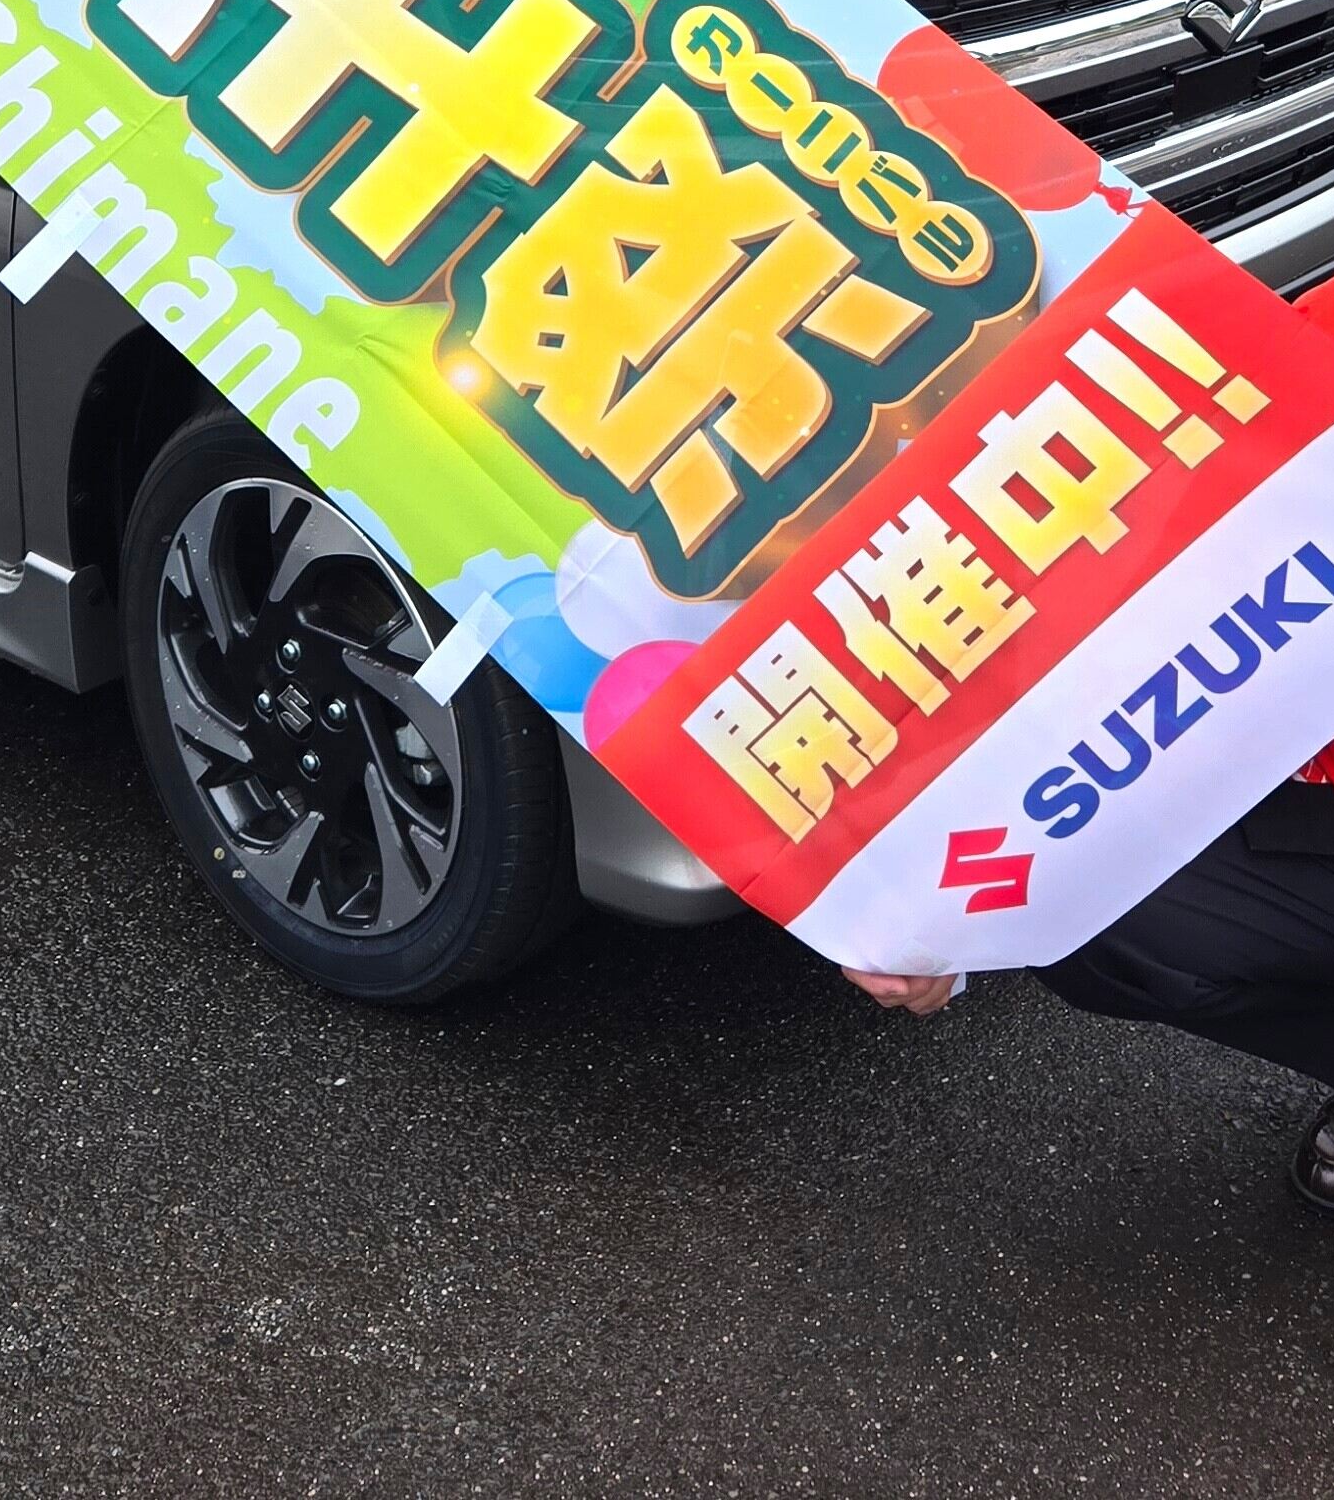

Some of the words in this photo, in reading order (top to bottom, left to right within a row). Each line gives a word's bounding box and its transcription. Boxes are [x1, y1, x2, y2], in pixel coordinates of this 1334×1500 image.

[686, 13, 974, 273] カーニバル
